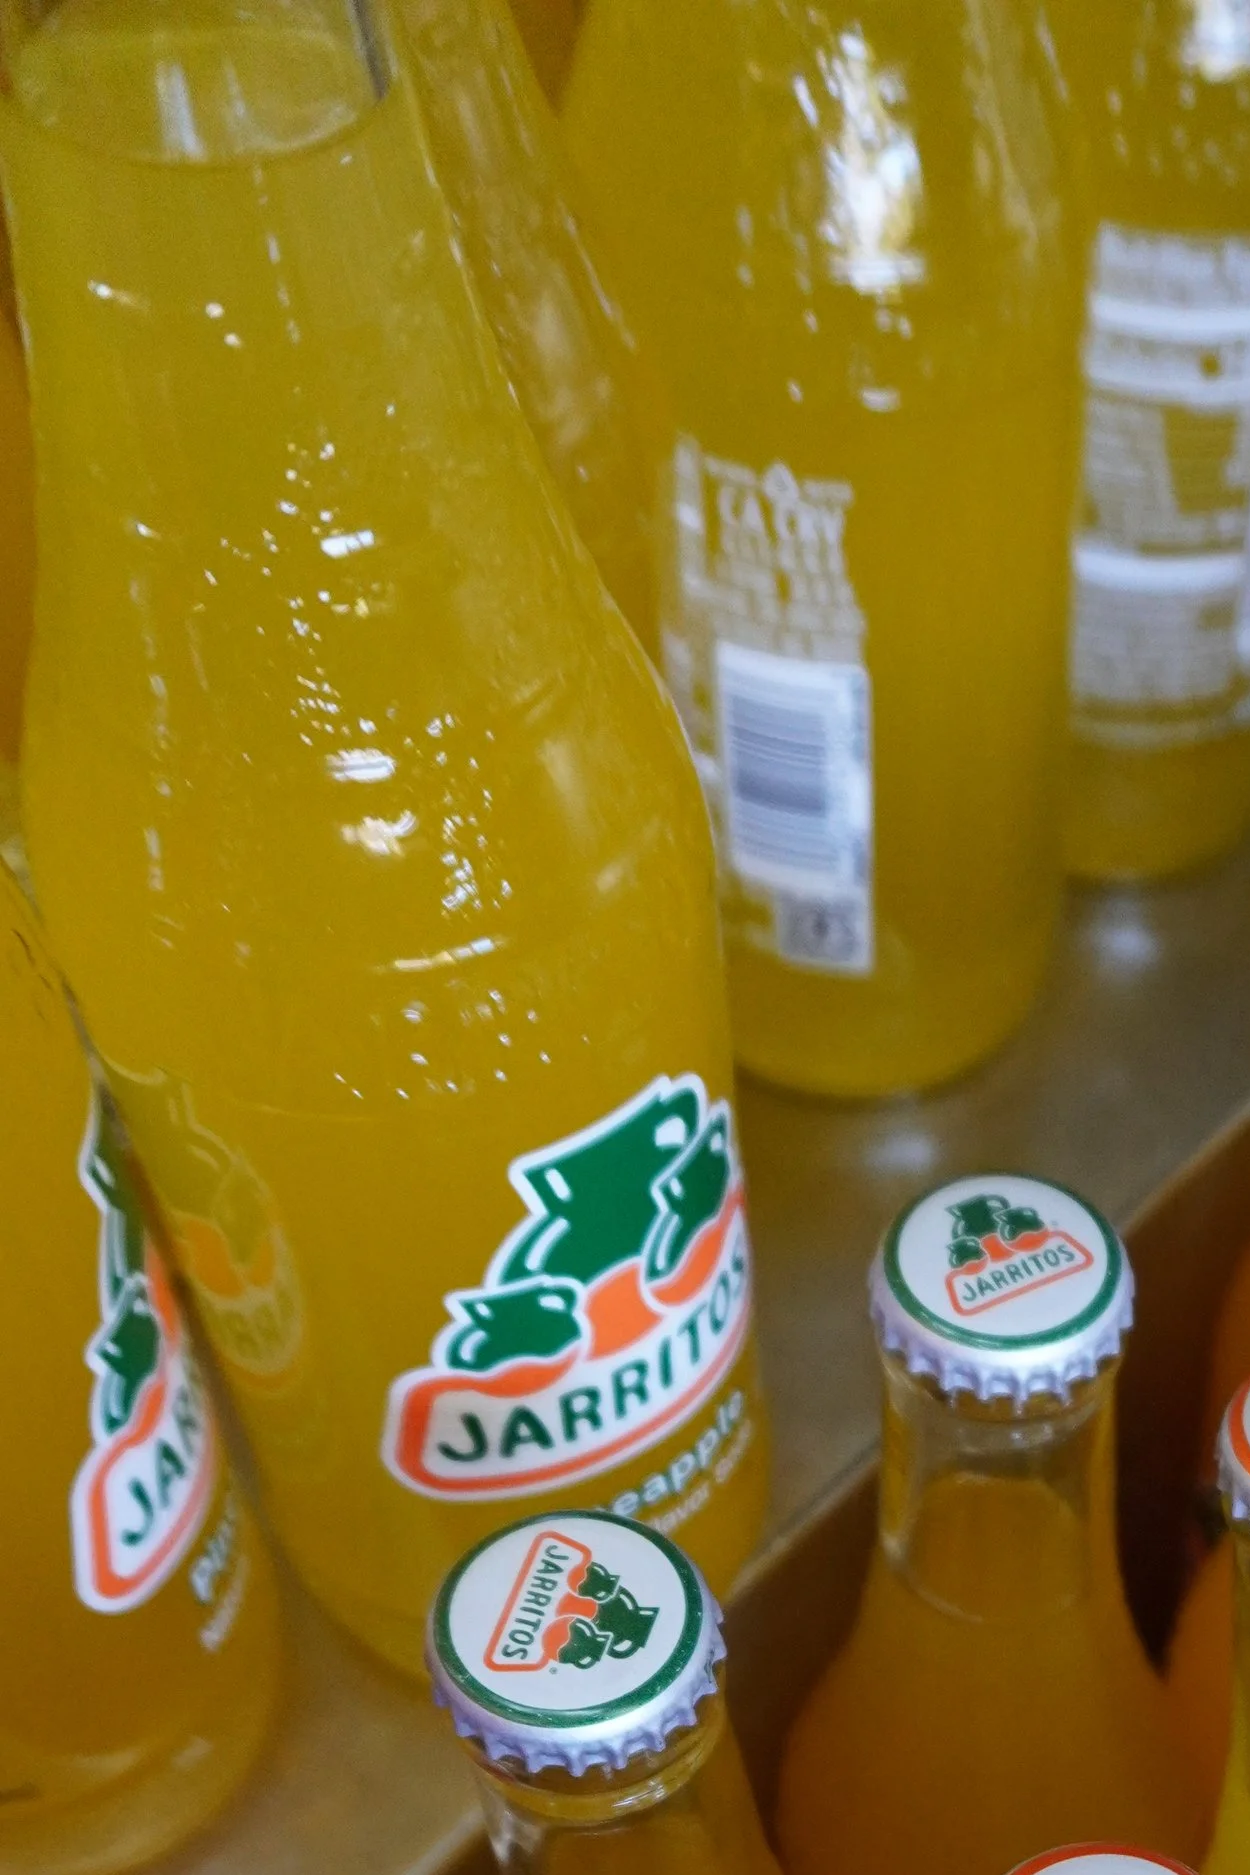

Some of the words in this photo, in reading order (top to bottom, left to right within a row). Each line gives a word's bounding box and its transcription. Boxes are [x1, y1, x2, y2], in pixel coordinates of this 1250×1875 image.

[962, 1243, 1077, 1302] JARRITOS
[437, 1250, 743, 1463] JARRITOS
[501, 1544, 570, 1661] JARRITOS
